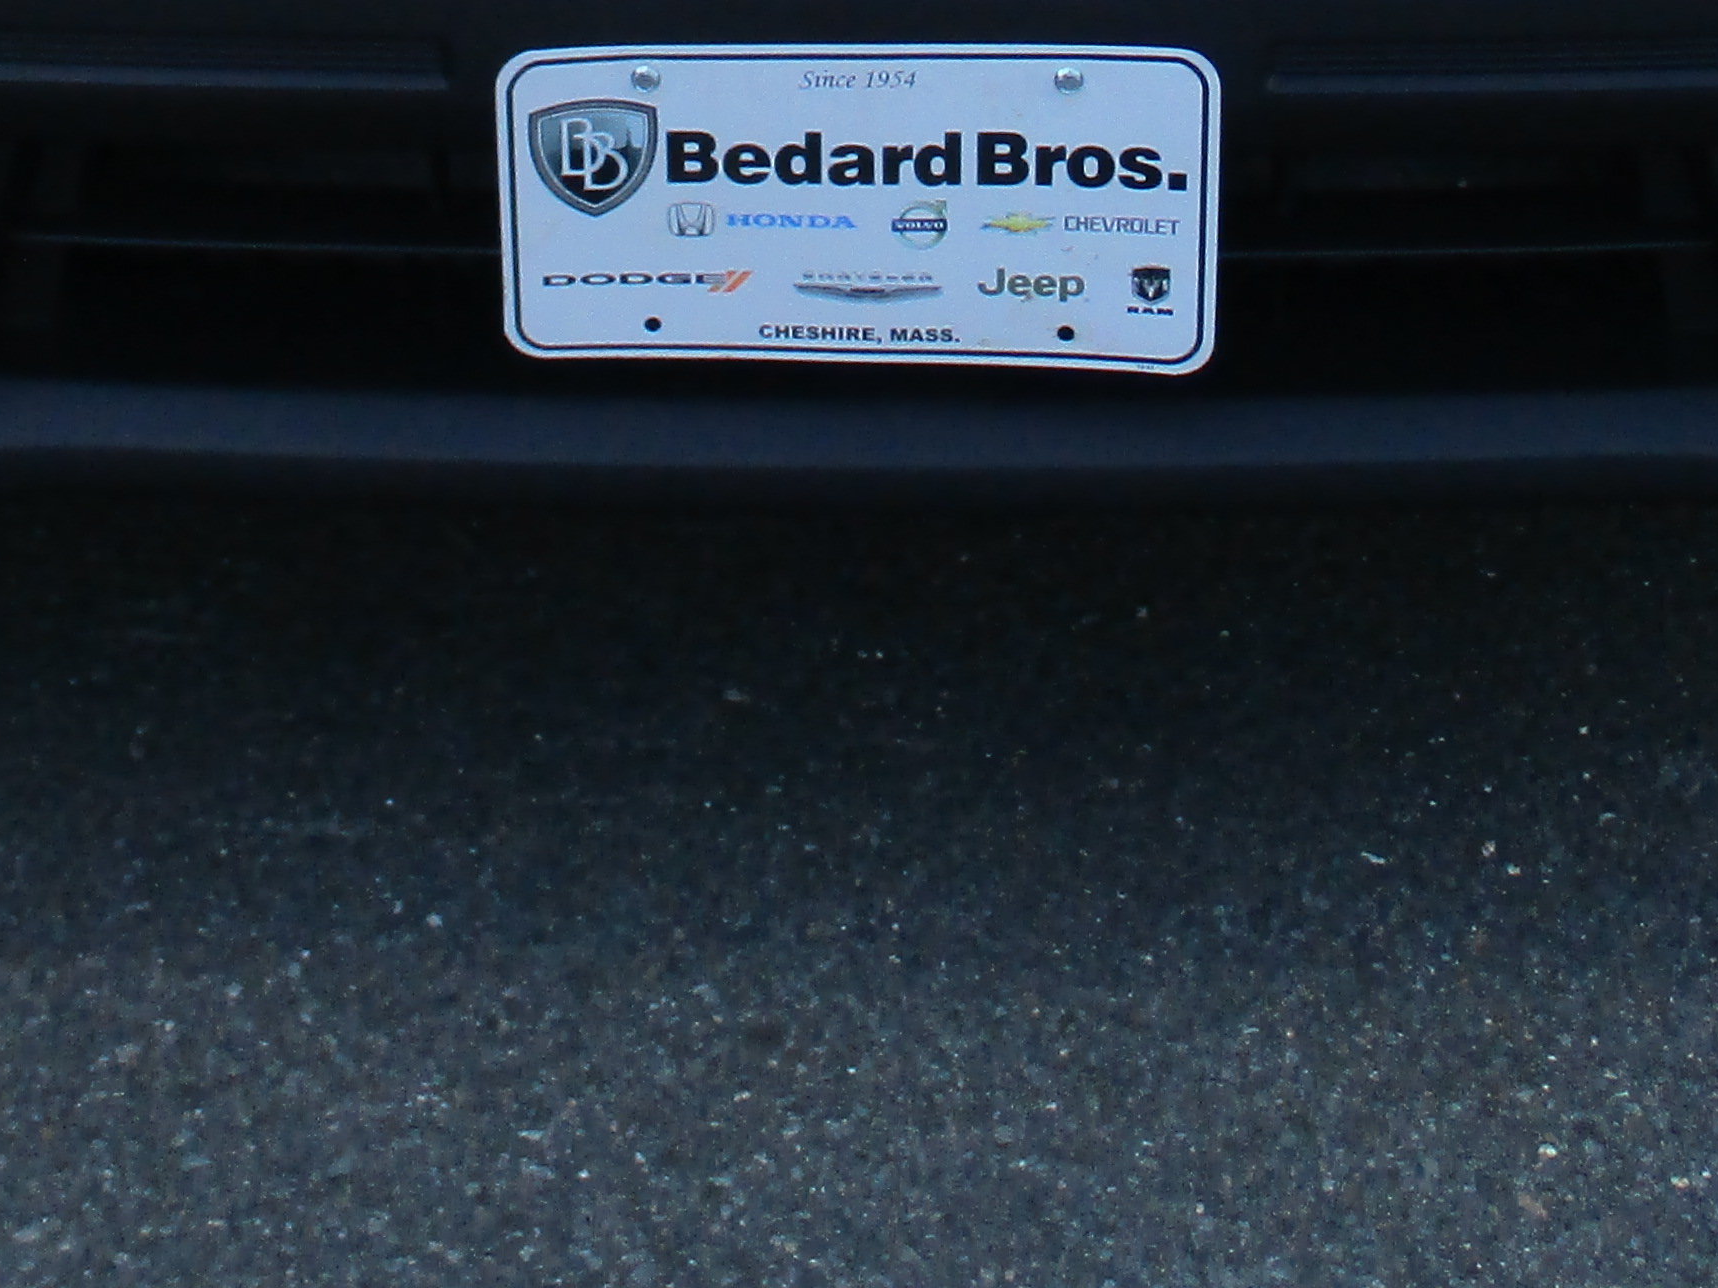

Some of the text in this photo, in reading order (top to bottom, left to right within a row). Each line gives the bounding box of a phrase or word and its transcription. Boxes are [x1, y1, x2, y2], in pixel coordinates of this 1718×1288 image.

[798, 69, 917, 90] Since 1954
[666, 130, 1188, 191] Bedard Bros.
[726, 214, 857, 230] HONDA
[1063, 215, 1181, 236] CHEVROLET
[542, 272, 727, 286] DODGE
[978, 267, 1085, 302] Jeep
[758, 324, 962, 344] CHESHIRE, MASS.
